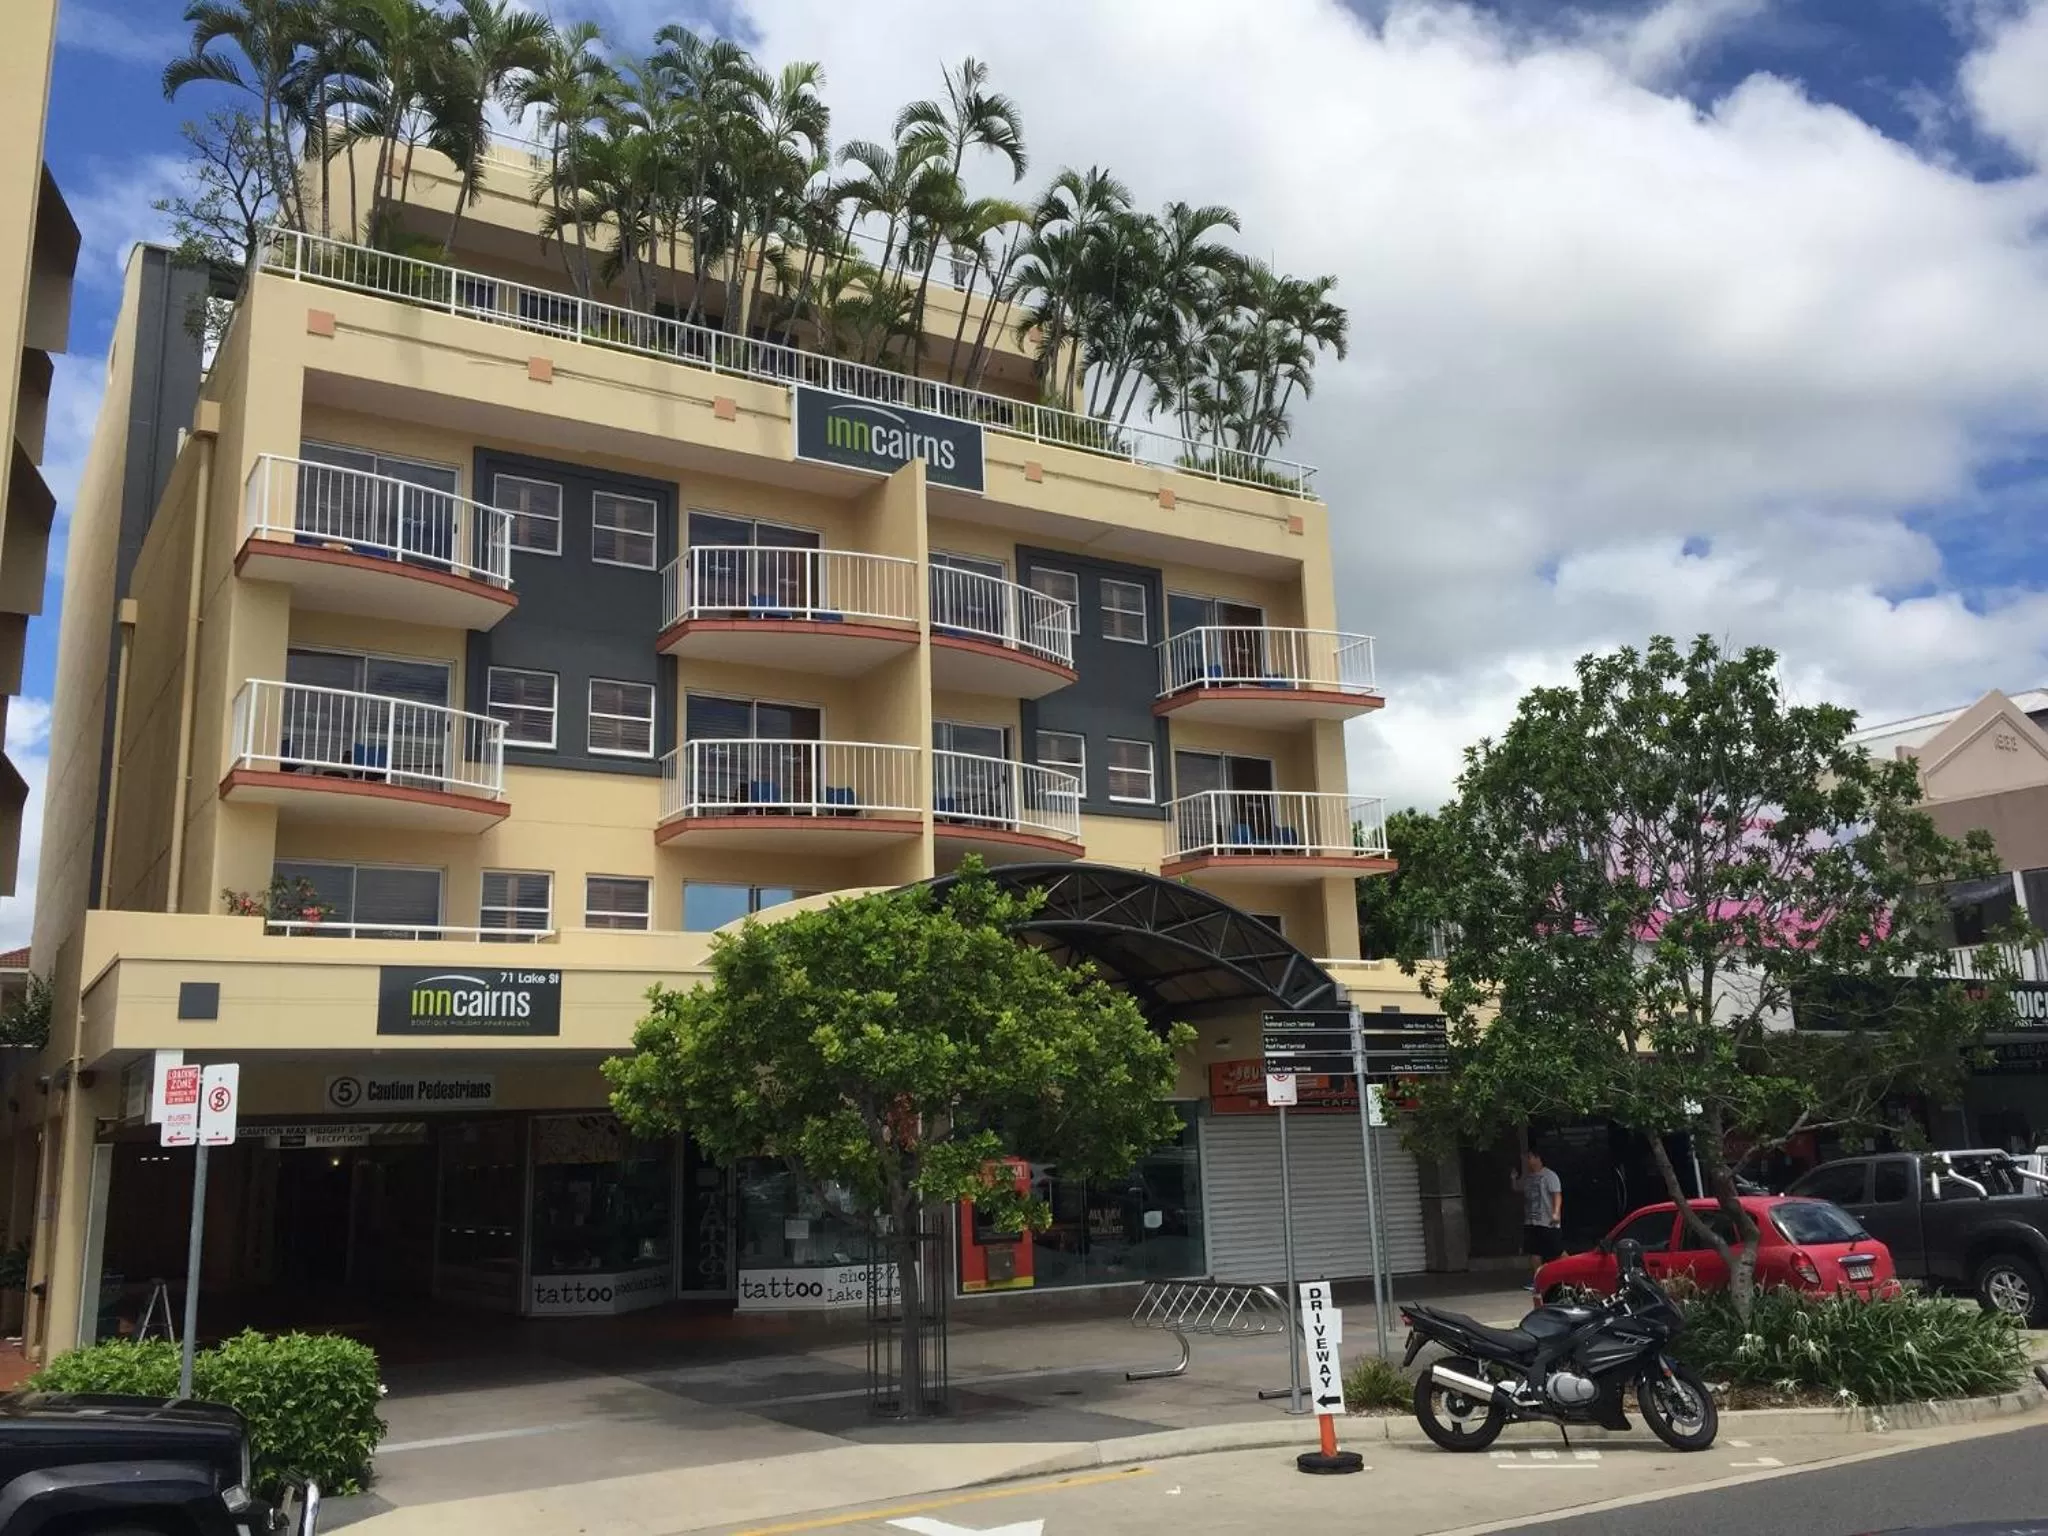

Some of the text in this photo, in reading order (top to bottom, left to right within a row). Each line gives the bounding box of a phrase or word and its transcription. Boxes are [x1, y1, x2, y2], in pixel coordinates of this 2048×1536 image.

[826, 413, 956, 470] inncairns
[500, 972, 560, 984] 71 Lake St
[411, 985, 531, 1017] inncairns
[168, 1069, 197, 1081] LOADING
[170, 1079, 194, 1090] ZONE
[337, 1080, 492, 1102] 5 Caution Pedestrians
[238, 1127, 284, 1137] CAUTION
[310, 1126, 346, 1135] HEIGHT
[315, 1135, 363, 1144] RECEPTION
[534, 1282, 613, 1304] tattoo
[740, 1276, 823, 1299] tattoo
[827, 1283, 901, 1303] Lake Stre
[1309, 1287, 1331, 1388] DRIVEWAY
